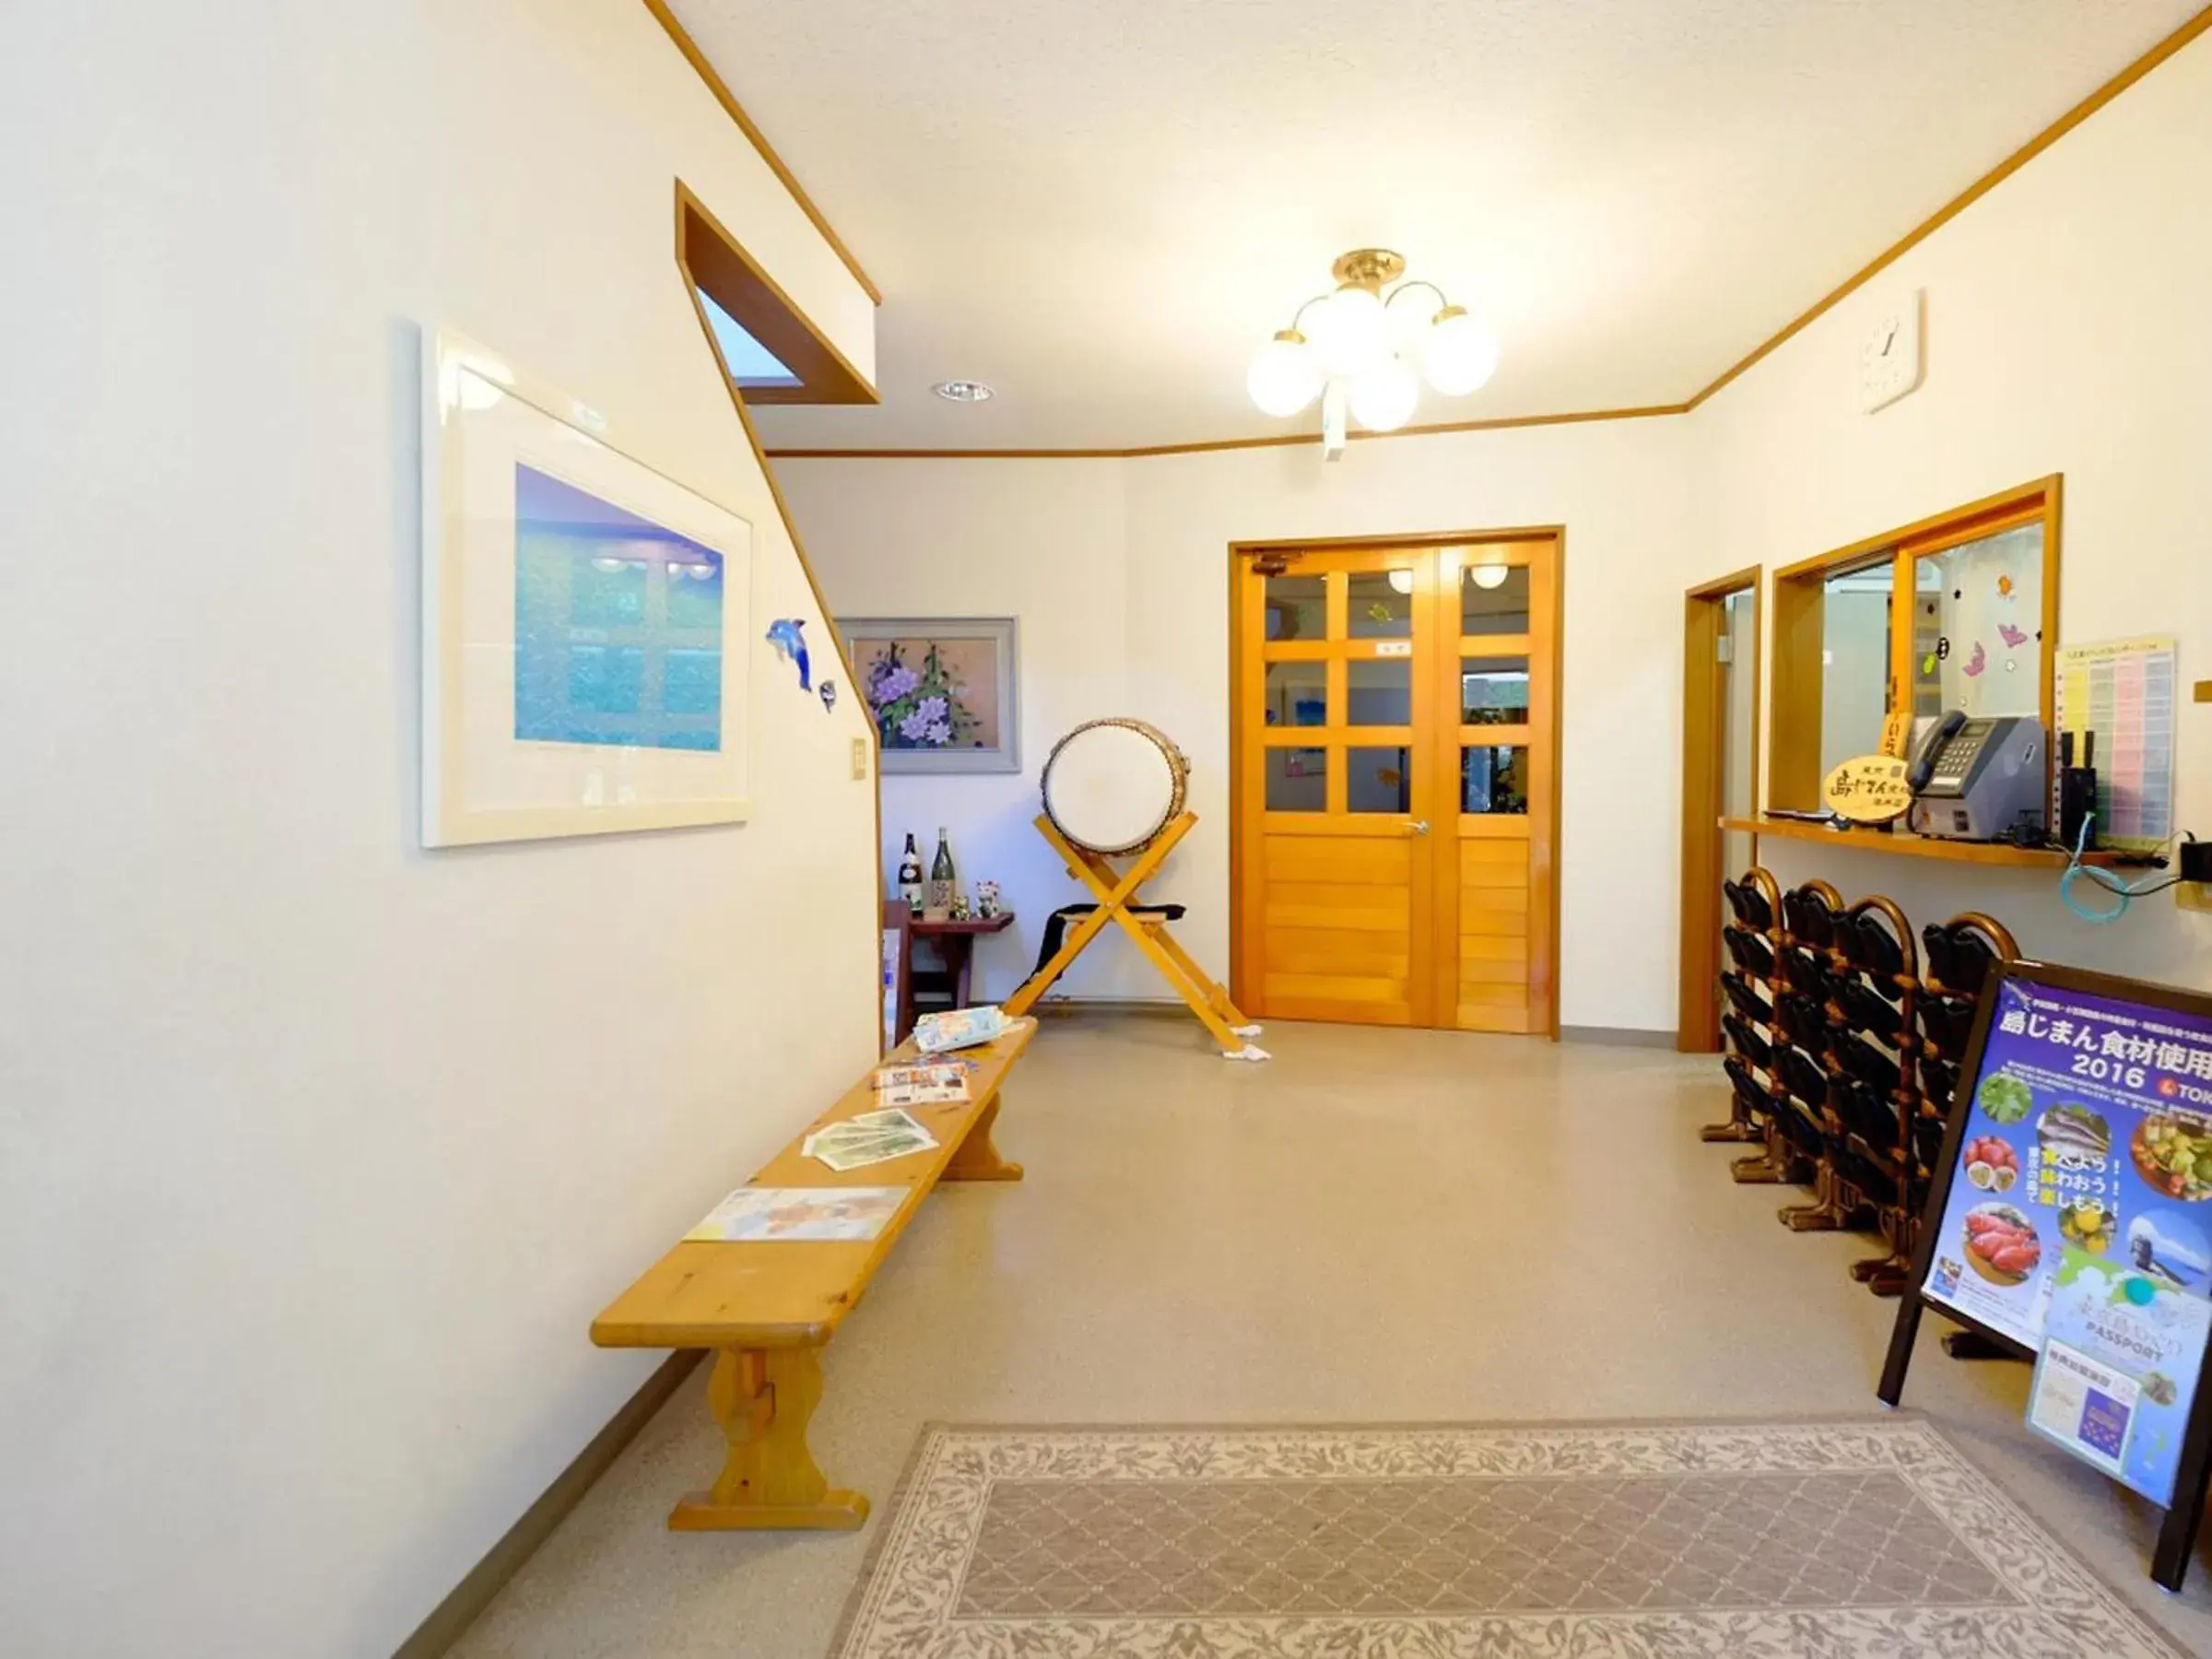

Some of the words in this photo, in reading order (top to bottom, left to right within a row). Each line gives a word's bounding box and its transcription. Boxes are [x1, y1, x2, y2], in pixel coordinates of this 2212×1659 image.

[1999, 1010, 2212, 1080] 島じまん食材使用
[2071, 1053, 2146, 1088] 2016
[2086, 1321, 2163, 1362] PASSPORT
